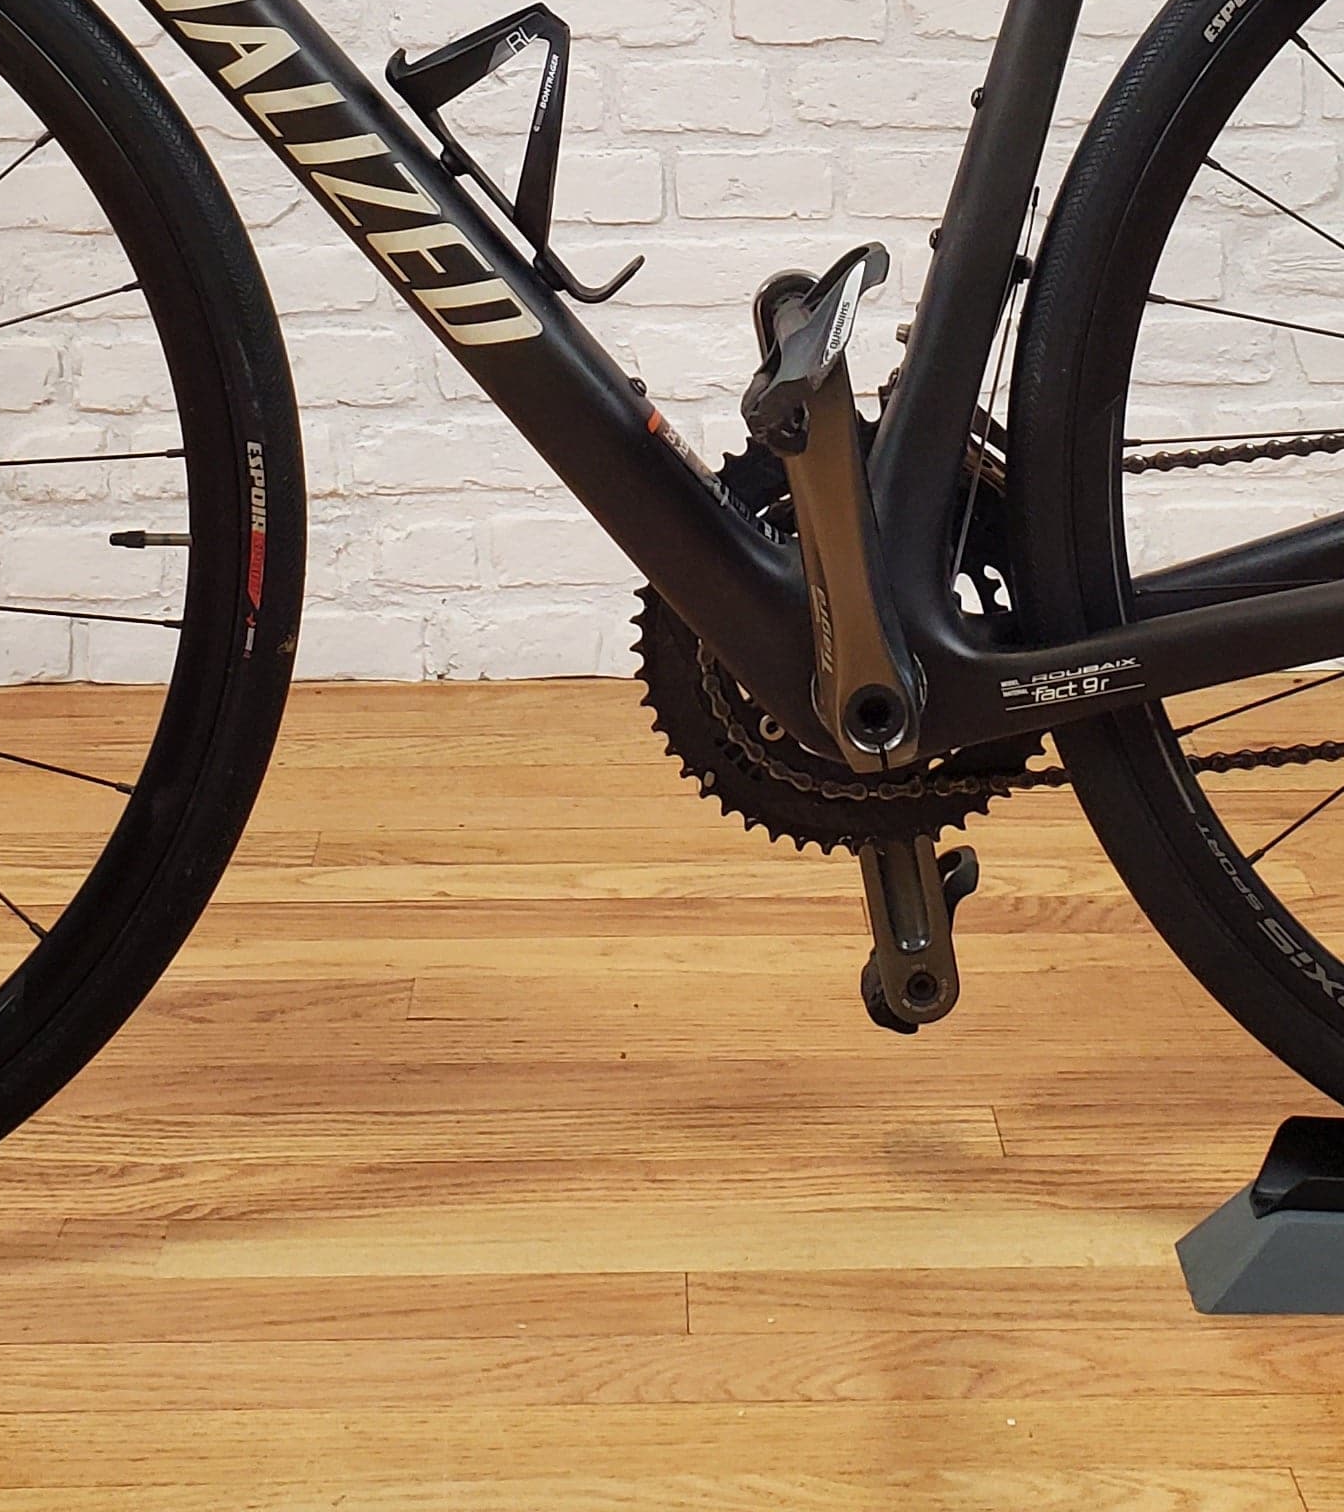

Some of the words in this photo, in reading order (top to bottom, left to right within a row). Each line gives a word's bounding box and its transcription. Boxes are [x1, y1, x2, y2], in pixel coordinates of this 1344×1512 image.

[506, 26, 539, 56] RL
[539, 53, 560, 110] BONTRAGER
[829, 301, 851, 350] SHIMANO
[246, 441, 267, 533] ESPOIR
[1031, 656, 1137, 682] ROUBAIX
[1194, 821, 1265, 912] SPORT
